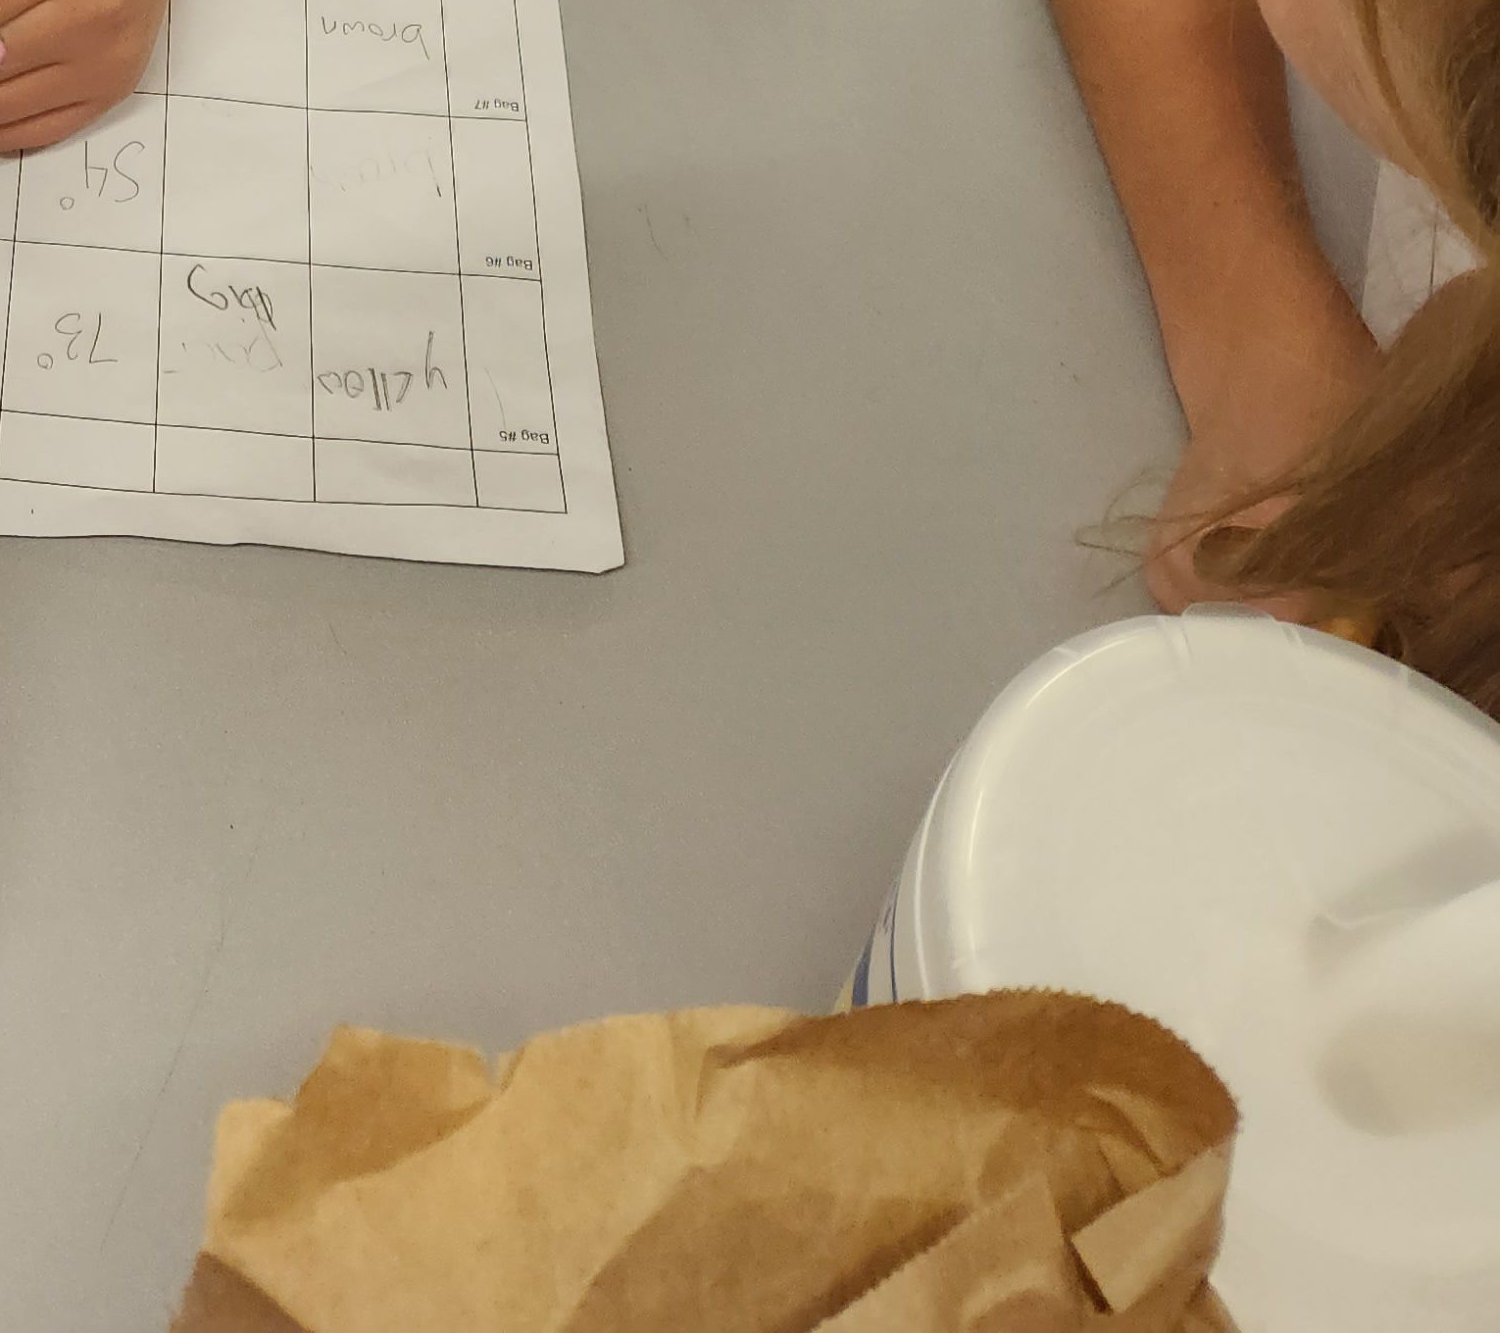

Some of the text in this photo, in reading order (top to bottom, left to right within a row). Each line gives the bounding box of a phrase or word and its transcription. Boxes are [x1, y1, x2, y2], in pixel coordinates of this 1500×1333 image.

[321, 14, 430, 61] brown
[474, 97, 521, 113] Bag #7
[484, 254, 534, 272] Bag #6
[498, 428, 551, 446] Bag #5
